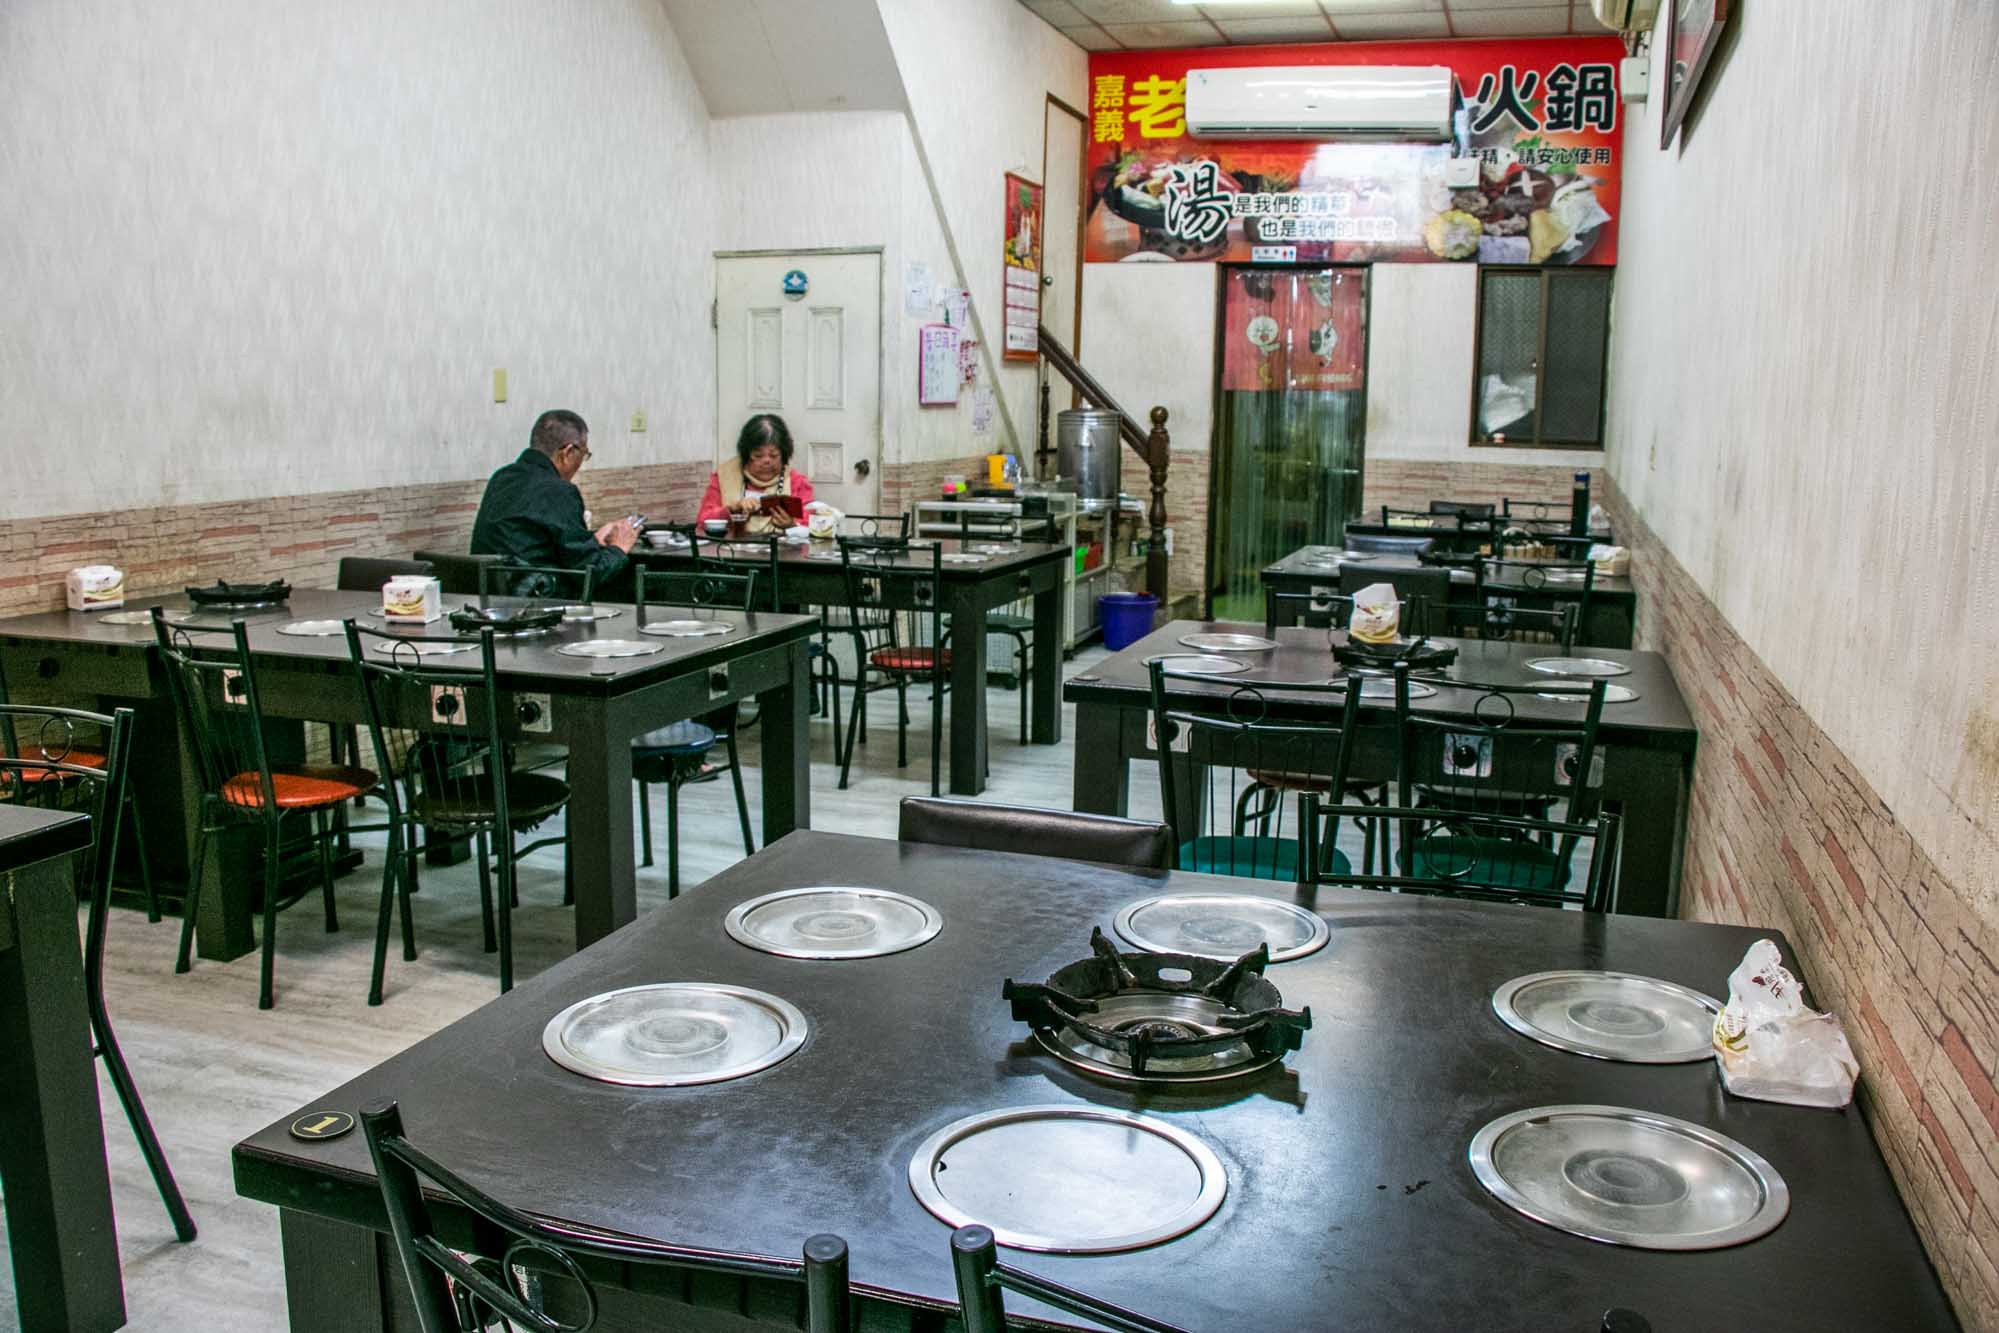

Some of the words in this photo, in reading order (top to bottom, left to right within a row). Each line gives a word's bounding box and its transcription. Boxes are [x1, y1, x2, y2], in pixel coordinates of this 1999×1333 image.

[1094, 75, 1125, 141] 嘉義
[1128, 75, 1186, 138] 老
[1472, 66, 1614, 131] 火鍋
[1167, 164, 1232, 239] 湯
[302, 1116, 339, 1134] 1
